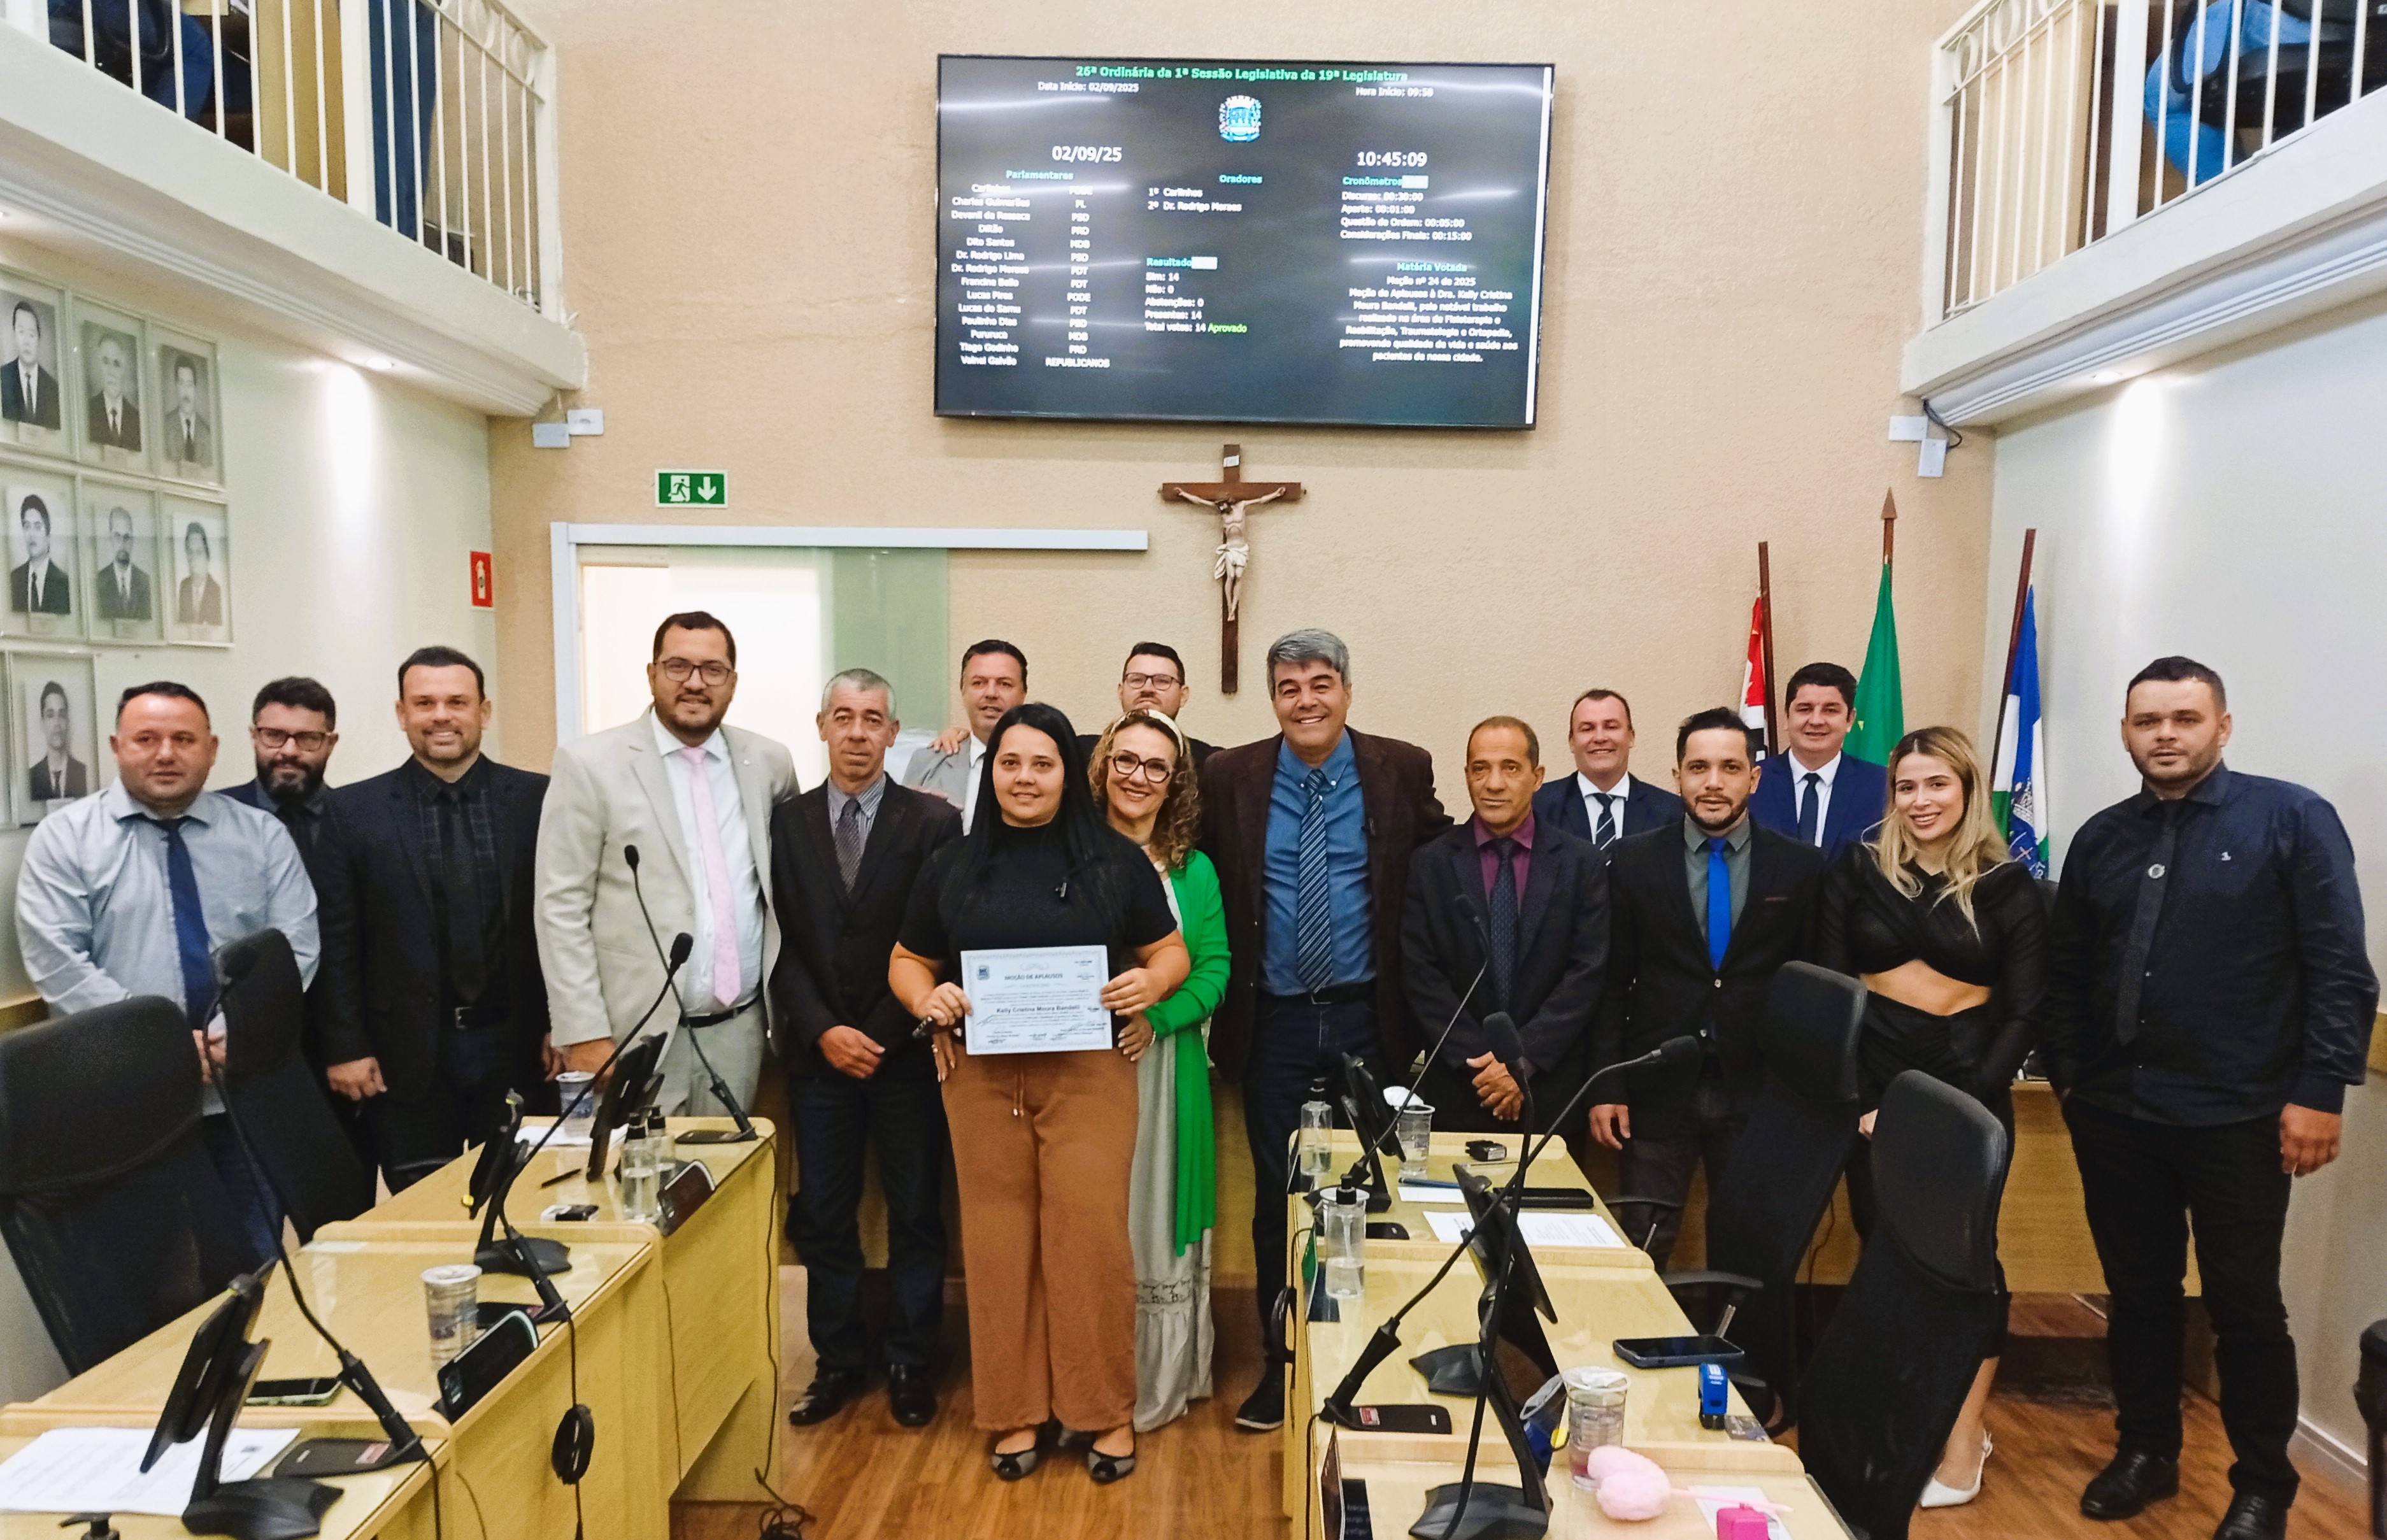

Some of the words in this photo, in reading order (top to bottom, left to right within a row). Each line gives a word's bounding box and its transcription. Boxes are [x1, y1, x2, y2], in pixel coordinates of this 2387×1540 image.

[1100, 66, 1154, 78] Ordinária
[1157, 67, 1171, 78] da
[1192, 68, 1232, 79] Sessão
[1235, 69, 1297, 82] Legislativa
[1300, 69, 1315, 80] da
[1343, 70, 1408, 83] Legislatura
[1037, 82, 1058, 91] Data
[1060, 81, 1087, 91] Início:
[1088, 82, 1139, 93] 02/09/2025
[1355, 87, 1377, 96] Hora
[1051, 146, 1122, 162] 02/09/25
[1357, 151, 1428, 167] 10:45:09
[1006, 171, 1074, 180] Parlamentares
[1219, 175, 1263, 184] Oradores
[1343, 176, 1402, 186] Cronômetros
[1163, 187, 1203, 197] Carlinhos
[1383, 192, 1423, 201] 00:30:00
[1075, 199, 1087, 208] PL
[1163, 201, 1176, 211] Dr.
[1177, 201, 1210, 213] Rodrigo
[1211, 202, 1242, 212] Moraes
[1375, 204, 1415, 214] 00:01:00
[1341, 217, 1376, 227] Questão
[1377, 217, 1389, 226] de
[1390, 218, 1422, 227] Ordem:
[1425, 218, 1465, 227] 00:05:00
[1341, 230, 1400, 241] Considerações
[1432, 231, 1472, 241] 00:15:00
[986, 238, 1015, 246] Santos
[957, 250, 968, 259] Dr.
[971, 251, 1002, 261] Rodrigo
[1146, 257, 1192, 267] Resultado
[1397, 262, 1432, 271] Matéria
[1434, 263, 1467, 271] Votada
[951, 264, 964, 272] Dr.
[965, 264, 997, 274] Rodrigo
[1168, 273, 1179, 282] 14
[1386, 276, 1414, 286] Moção
[1428, 276, 1439, 285] 24
[1441, 276, 1453, 285] de
[1454, 277, 1476, 286] 2025
[1167, 285, 1174, 294] 0
[1349, 288, 1376, 299] Moção
[1437, 289, 1455, 298] Dra.
[1458, 290, 1479, 300] Kelly
[1480, 290, 1513, 299] Cristina
[967, 290, 991, 299] Lucas
[992, 291, 1013, 300] Pires
[1197, 297, 1204, 307] 0
[958, 304, 982, 312] Lucas
[984, 304, 995, 313] do
[997, 304, 1021, 313] Samu
[1191, 310, 1202, 320] 14
[962, 317, 997, 325] Paulinho
[999, 317, 1017, 326] Dias
[1195, 323, 1206, 332] 14
[1208, 322, 1247, 334] Aprovado
[1400, 327, 1459, 338] Traumatologia
[971, 330, 1008, 339] Pururuca
[960, 342, 983, 353] Tiago
[984, 343, 1018, 352] Godinho
[1339, 339, 1392, 348] promovendo
[1393, 339, 1434, 349] qualidade
[1476, 340, 1501, 350] saúde
[988, 356, 1016, 366] Galvão
[1046, 357, 1110, 367] REPUBLICANOS
[1372, 352, 1413, 361] pacientes
[1453, 353, 1483, 362] cidade.
